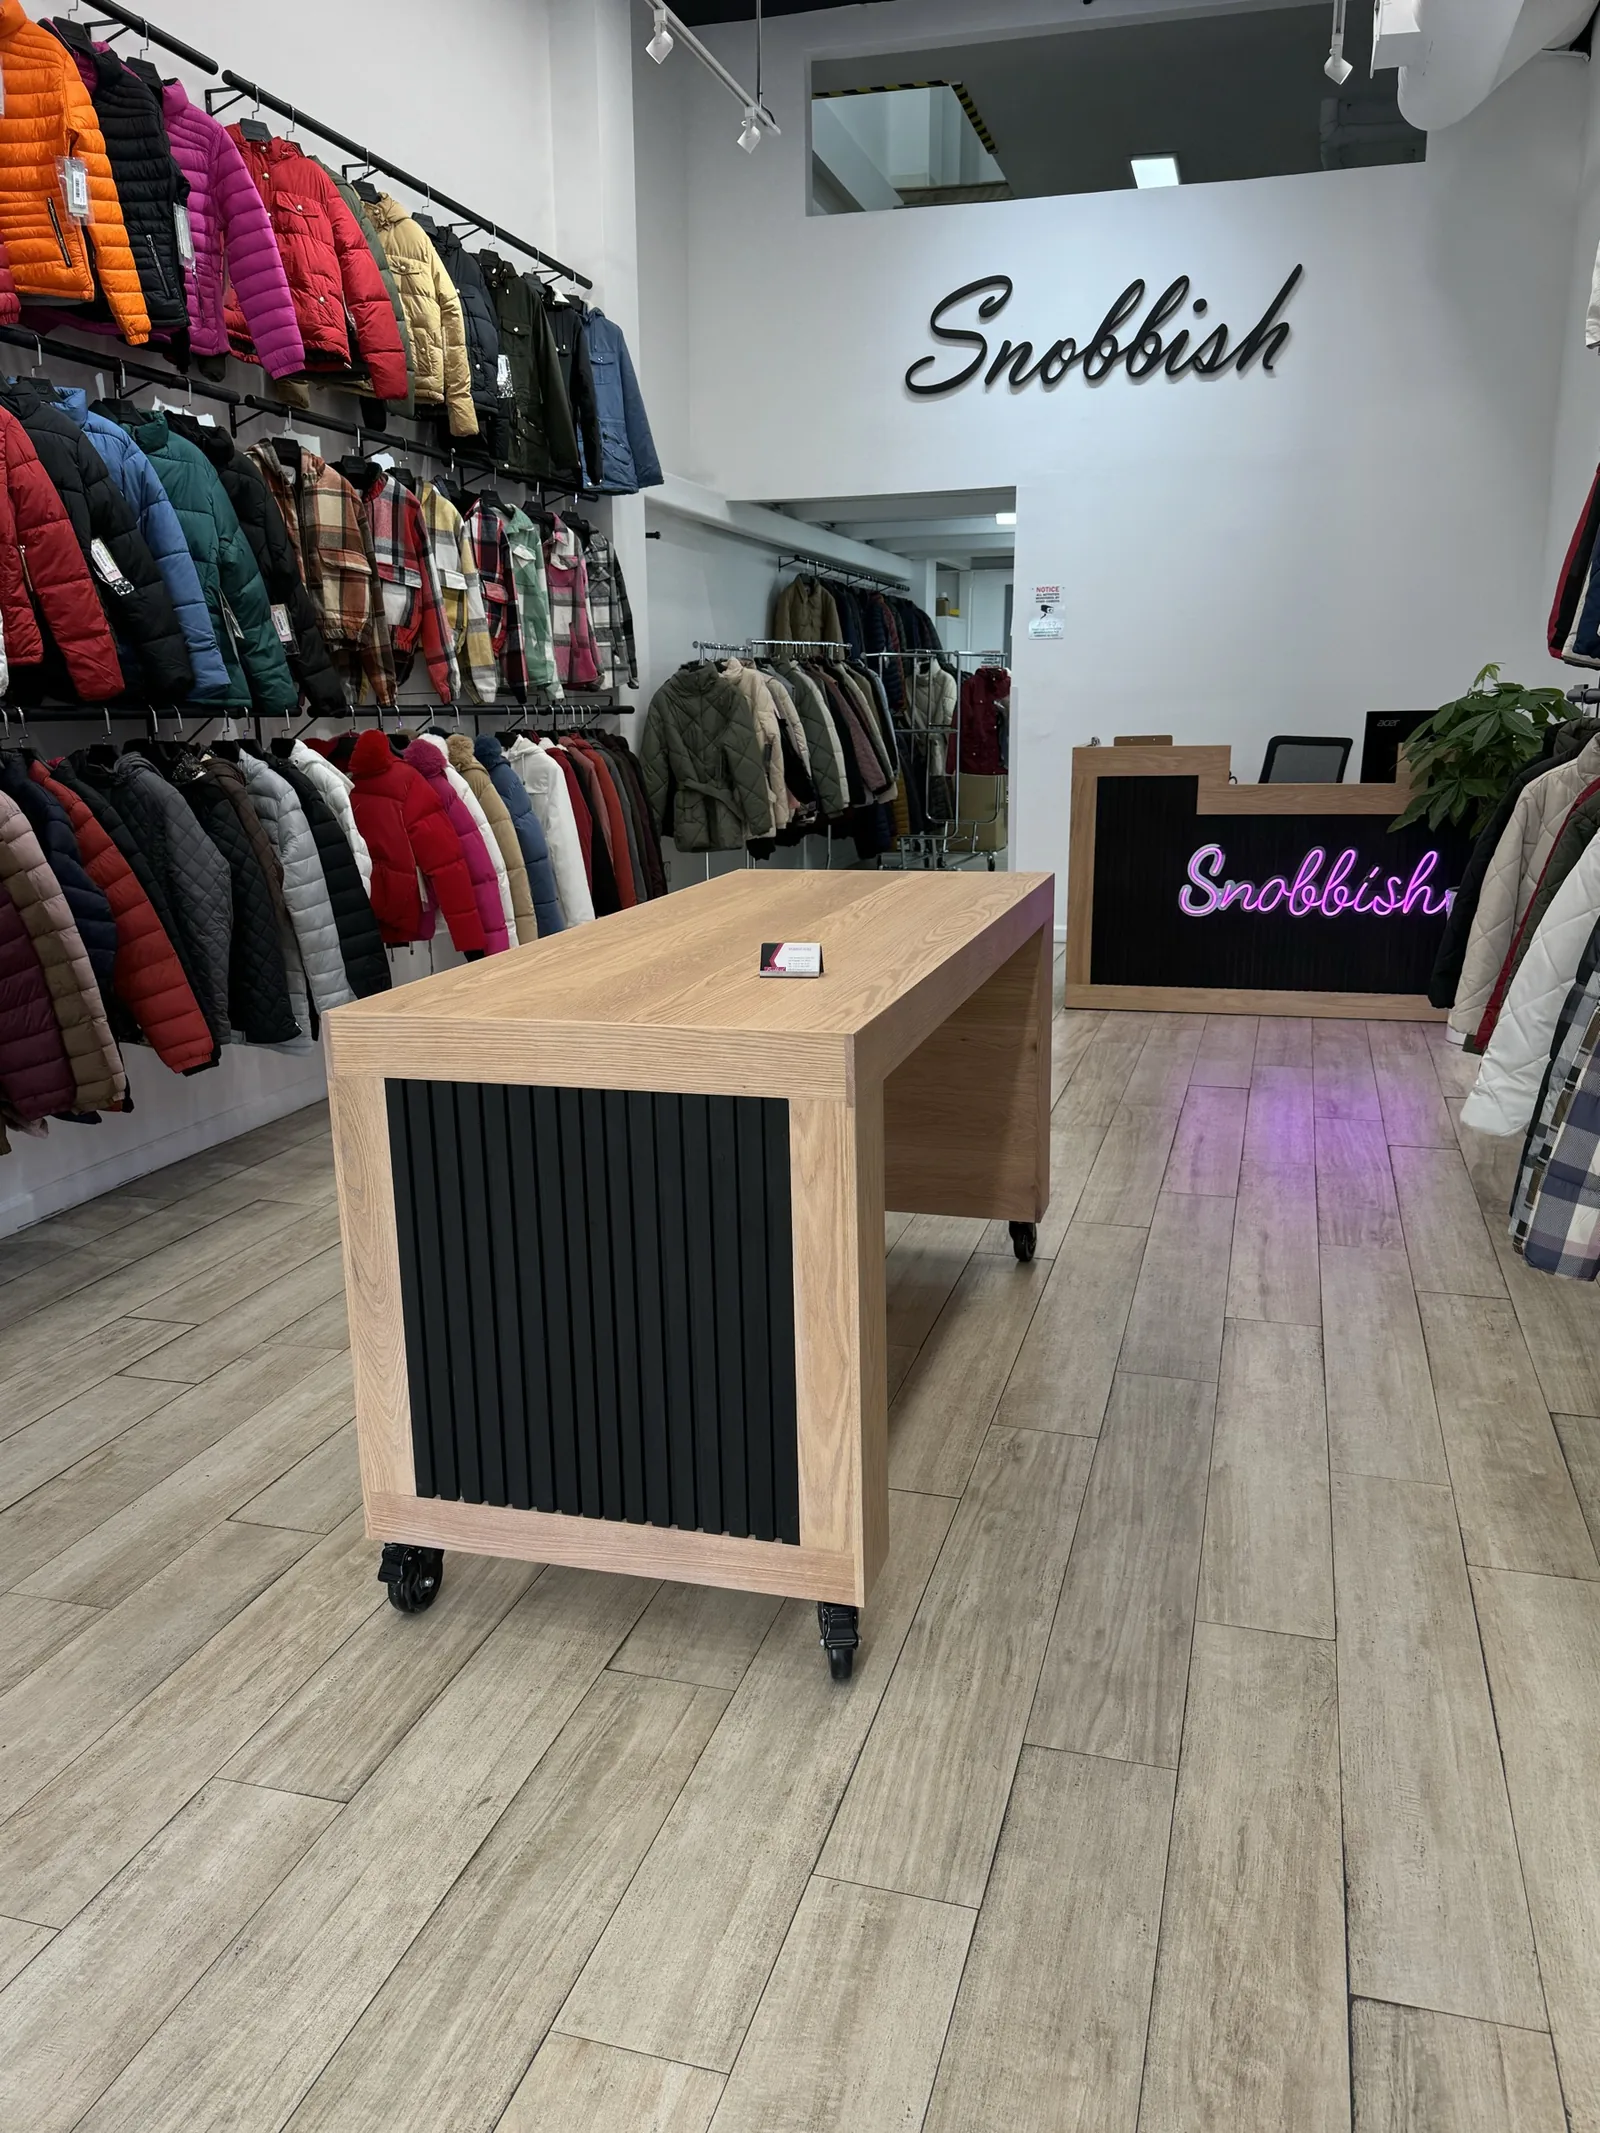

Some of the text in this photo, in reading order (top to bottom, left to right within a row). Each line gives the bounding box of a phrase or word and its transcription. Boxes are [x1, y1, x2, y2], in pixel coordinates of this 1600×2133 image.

[905, 263, 1303, 395] Snobbish
[1377, 719, 1400, 727] acer
[1180, 845, 1447, 917] Snobbish
